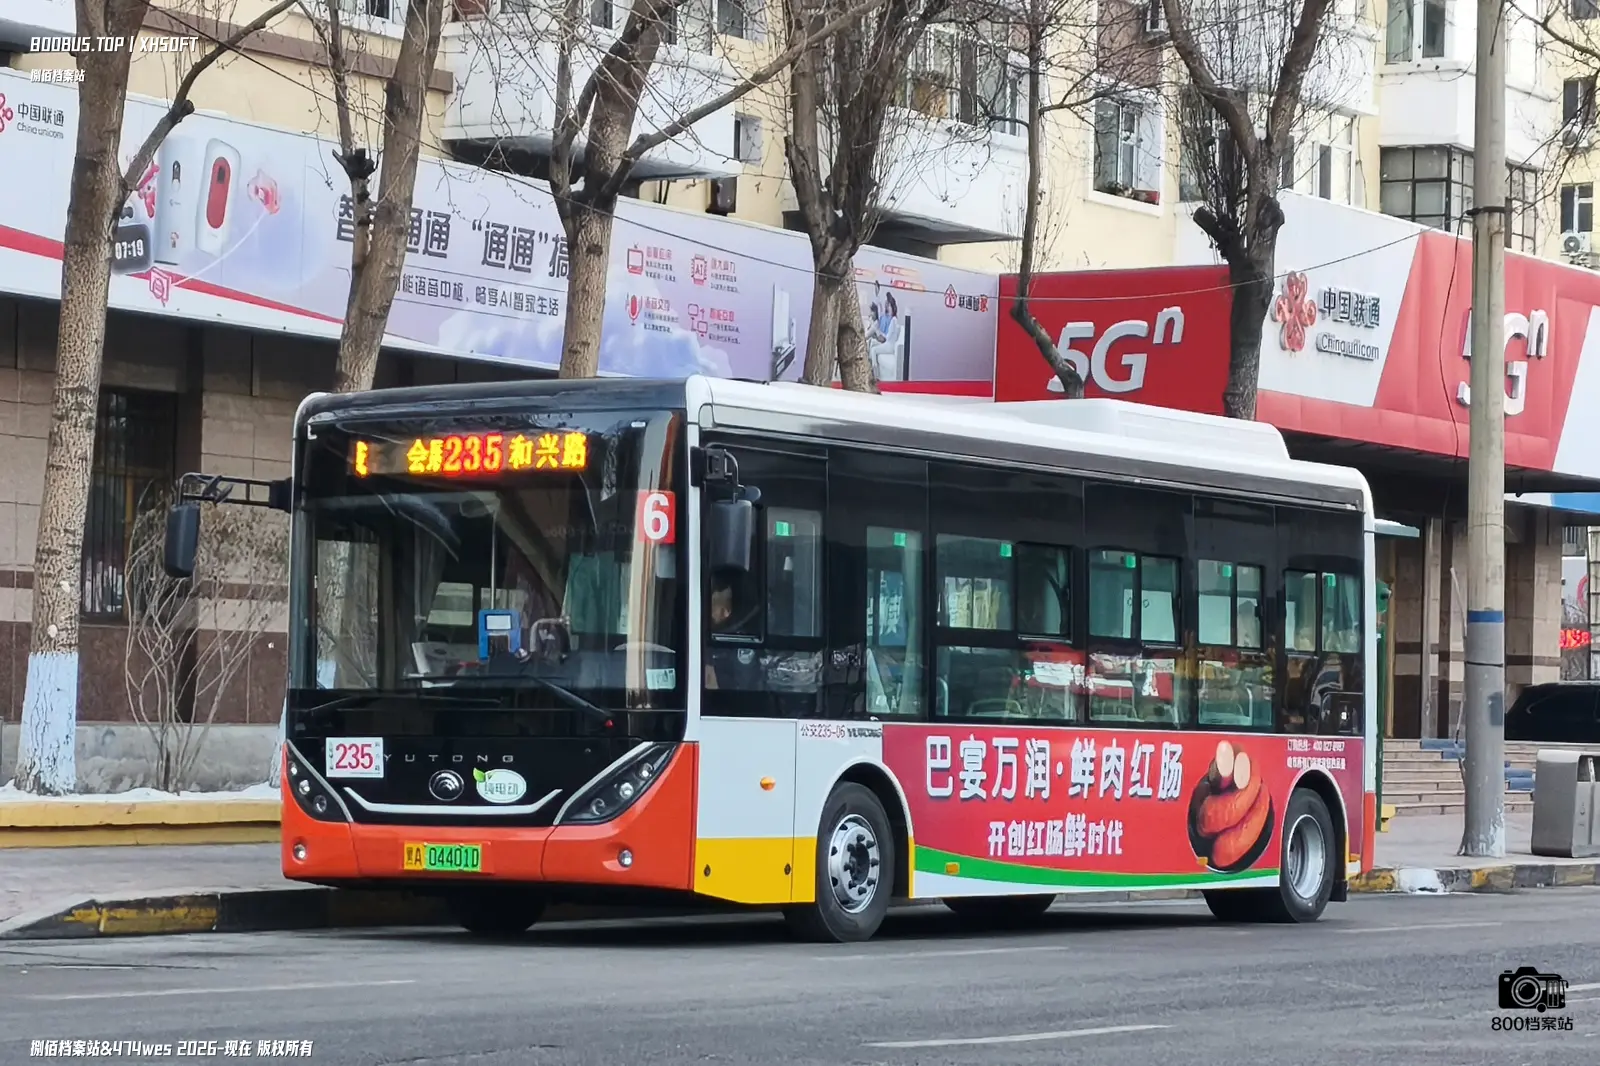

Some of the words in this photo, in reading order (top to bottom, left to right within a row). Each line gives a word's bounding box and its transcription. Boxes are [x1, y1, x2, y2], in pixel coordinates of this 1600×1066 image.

[17, 102, 64, 127] 中国联通
[38, 128, 64, 139] unicom
[114, 238, 144, 259] 07:19
[1319, 287, 1381, 328] 中国联通
[1316, 332, 1347, 354] China
[1348, 341, 1381, 361] unicom
[443, 434, 502, 473] 235
[508, 432, 587, 469] 和兴路
[643, 493, 669, 540] 6
[335, 743, 374, 770] 235
[384, 754, 514, 763] YUTONG
[987, 813, 1123, 857] 开创红肠鲜时代
